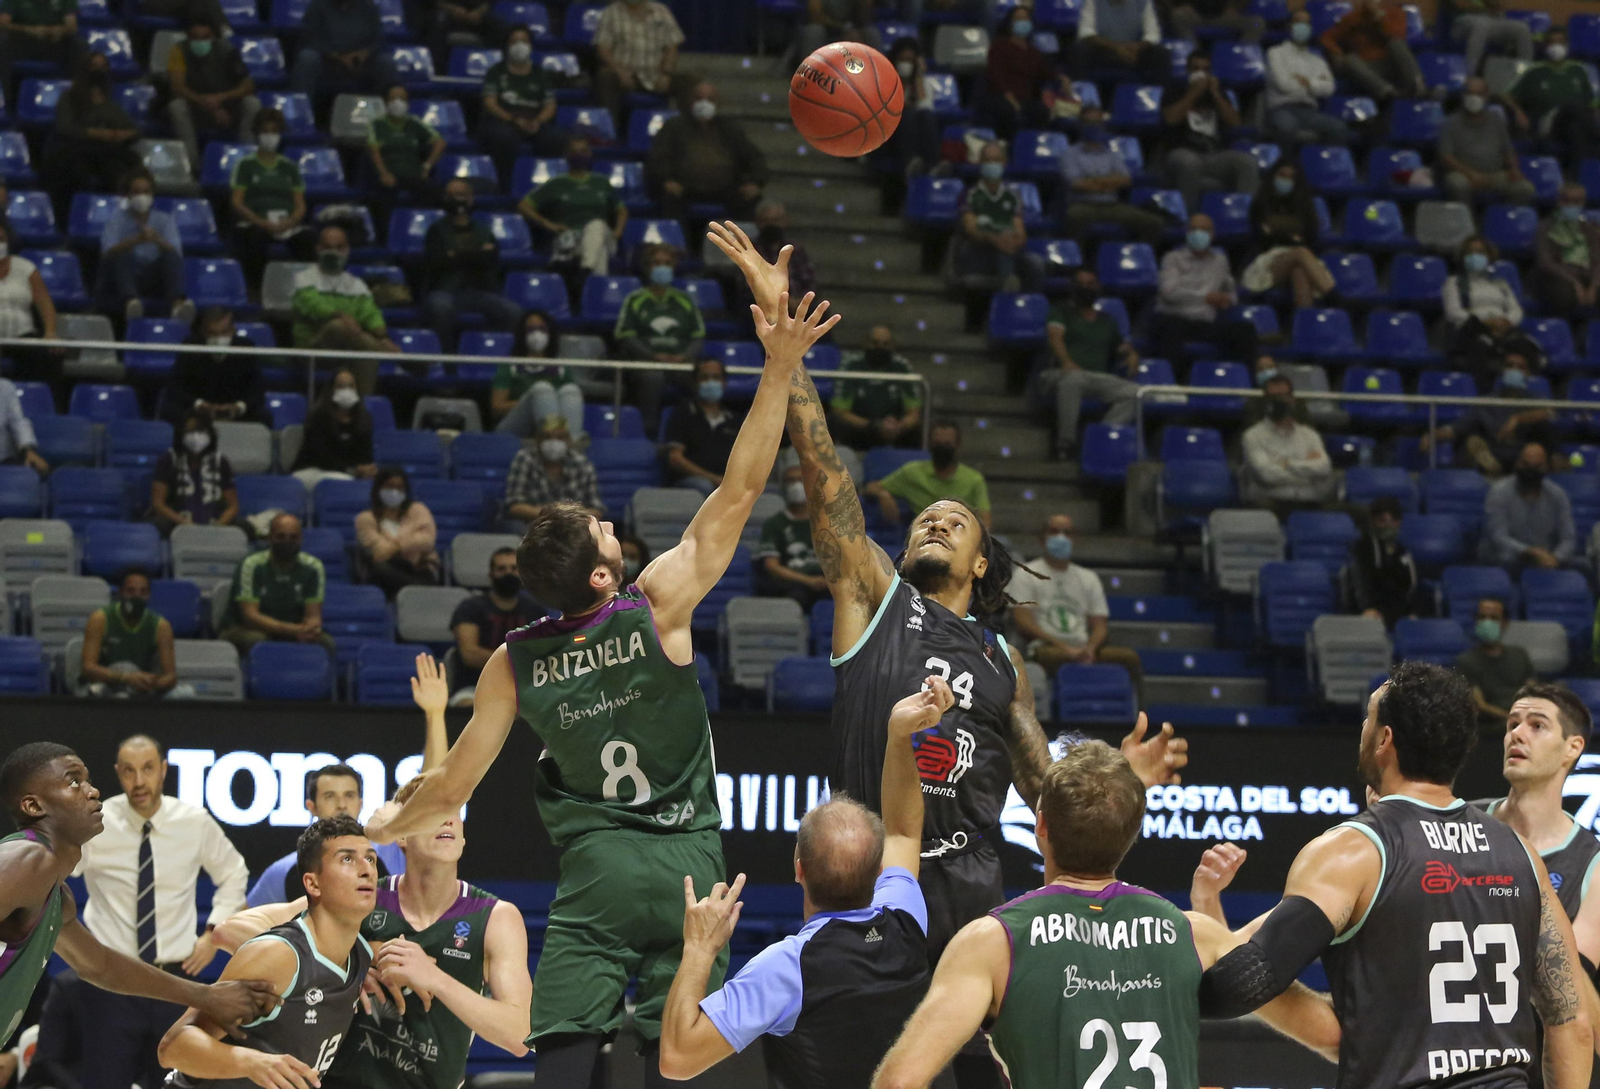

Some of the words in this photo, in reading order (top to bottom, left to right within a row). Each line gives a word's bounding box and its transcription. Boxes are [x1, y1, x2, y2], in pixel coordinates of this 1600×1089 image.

[532, 631, 647, 688] BRIZUELA
[600, 740, 652, 806] 8
[1146, 785, 1239, 812] COSTA
[1241, 785, 1298, 813] DEL
[1300, 786, 1359, 814] SOL
[1142, 810, 1264, 841] MÁLAGA
[1420, 820, 1490, 854] BURNS
[1461, 874, 1515, 887] arcese
[1488, 885, 1513, 897] move
[1030, 913, 1178, 951] ABROMAITIS
[1428, 921, 1521, 1025] 23
[311, 1032, 343, 1073] 12
[1079, 1018, 1169, 1089] 23
